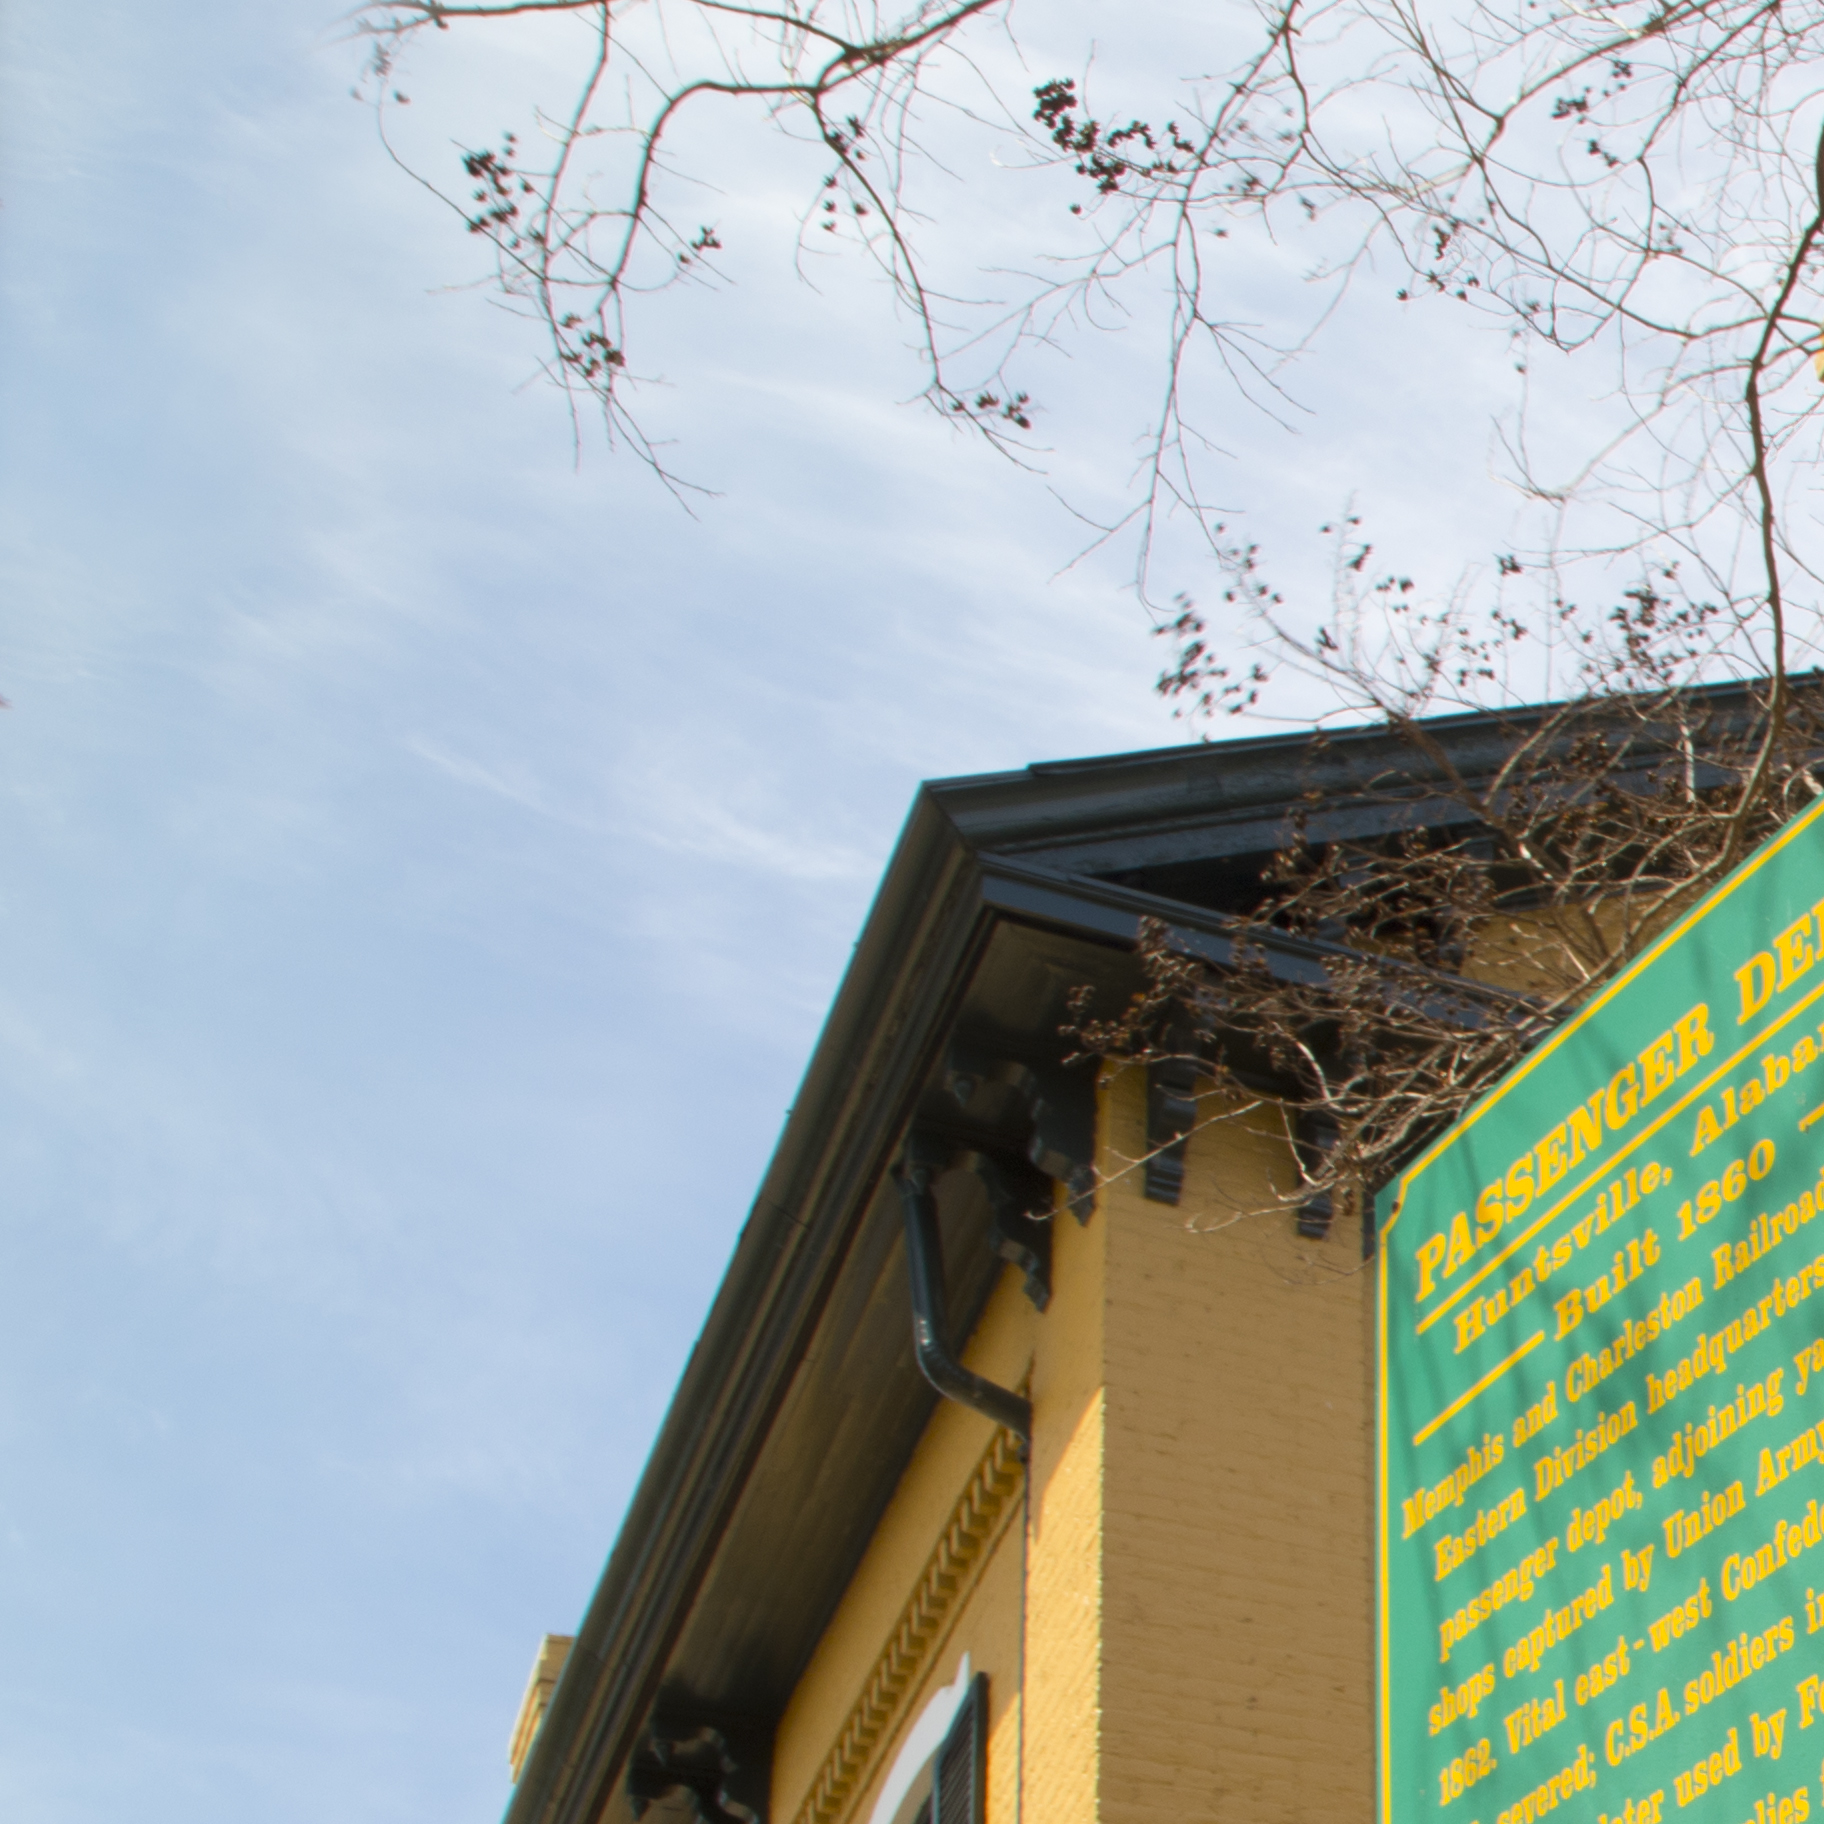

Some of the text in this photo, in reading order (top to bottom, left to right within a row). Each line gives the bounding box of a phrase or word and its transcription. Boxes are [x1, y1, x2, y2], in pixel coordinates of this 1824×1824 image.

[1414, 1001, 1717, 1304] PASSENGER
[1552, 1137, 1777, 1343] Built 1860
[1452, 1160, 1675, 1356] Huntsville,
[1401, 1432, 1506, 1541] Memphis
[1511, 1379, 1560, 1449] and
[1564, 1275, 1706, 1404] Charleston
[1432, 1486, 1528, 1583] Eastern
[1532, 1399, 1639, 1503] Division
[1427, 1662, 1497, 1738] shops
[1501, 1562, 1616, 1680] captured
[1620, 1542, 1656, 1594] by
[1661, 1479, 1748, 1560] Union
[1438, 1535, 1560, 1665] passenger
[1565, 1469, 1645, 1554] depot,
[1651, 1366, 1786, 1491] adjoining
[1438, 1736, 1498, 1808] 1862.
[1502, 1677, 1569, 1756] Vital
[1603, 1686, 1682, 1768] C.S.A.
[1682, 1614, 1797, 1717] soldiers
[1672, 1725, 1744, 1809] used
[1748, 1707, 1789, 1762] by
